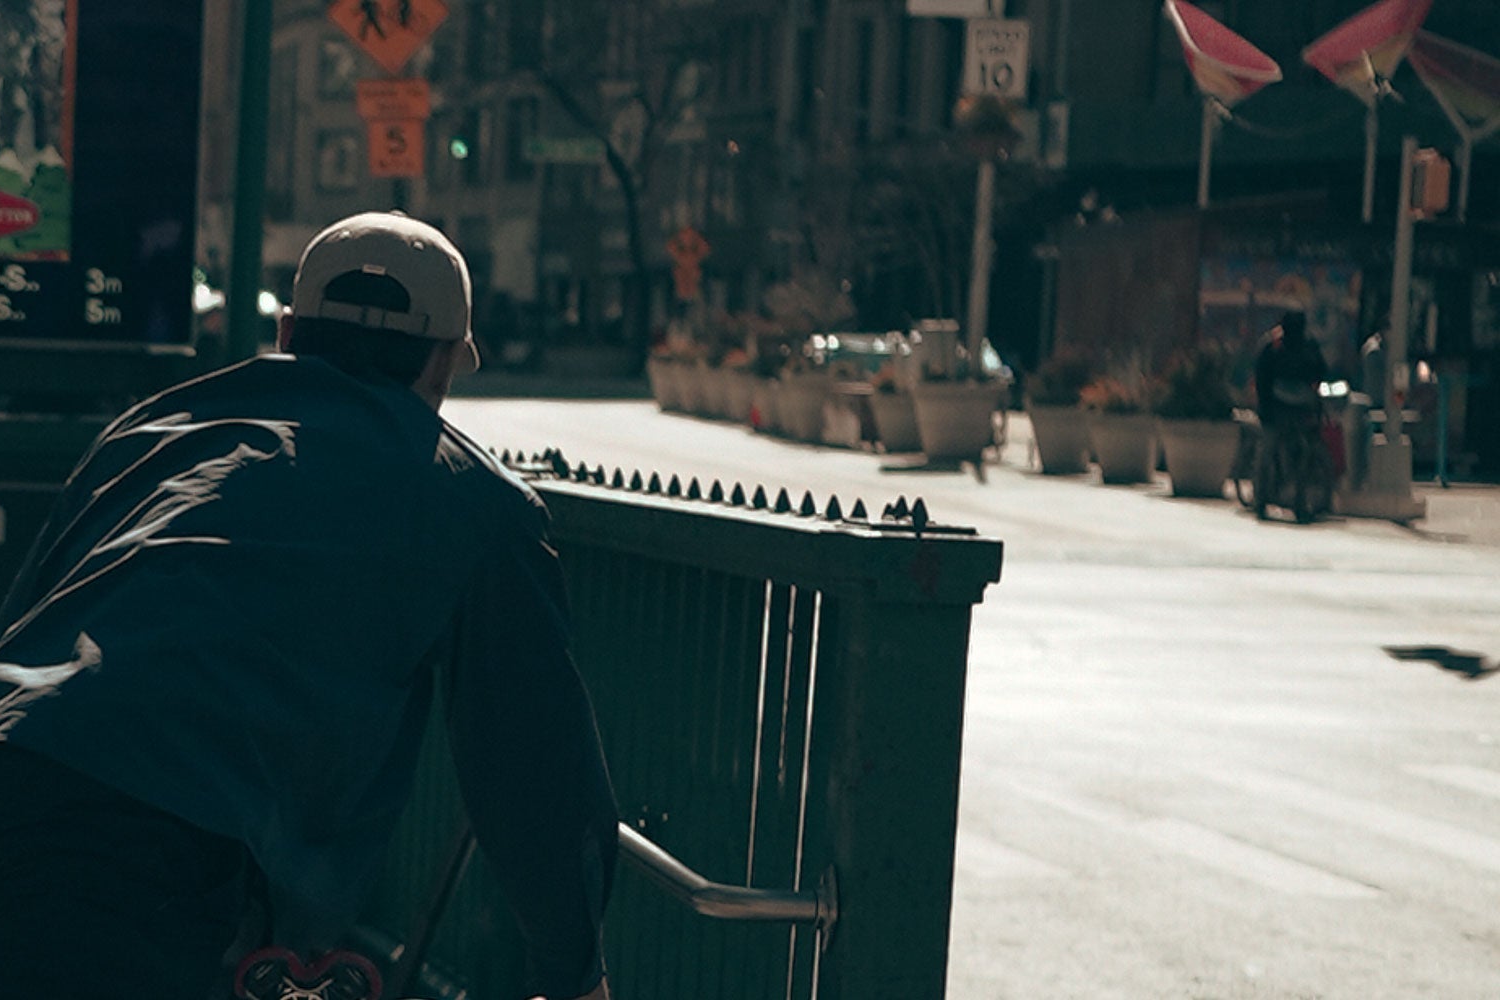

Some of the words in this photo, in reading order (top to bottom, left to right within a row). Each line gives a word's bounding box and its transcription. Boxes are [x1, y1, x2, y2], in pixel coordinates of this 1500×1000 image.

[979, 60, 1015, 91] 10
[85, 267, 123, 294] 3m
[85, 299, 123, 325] 5m
